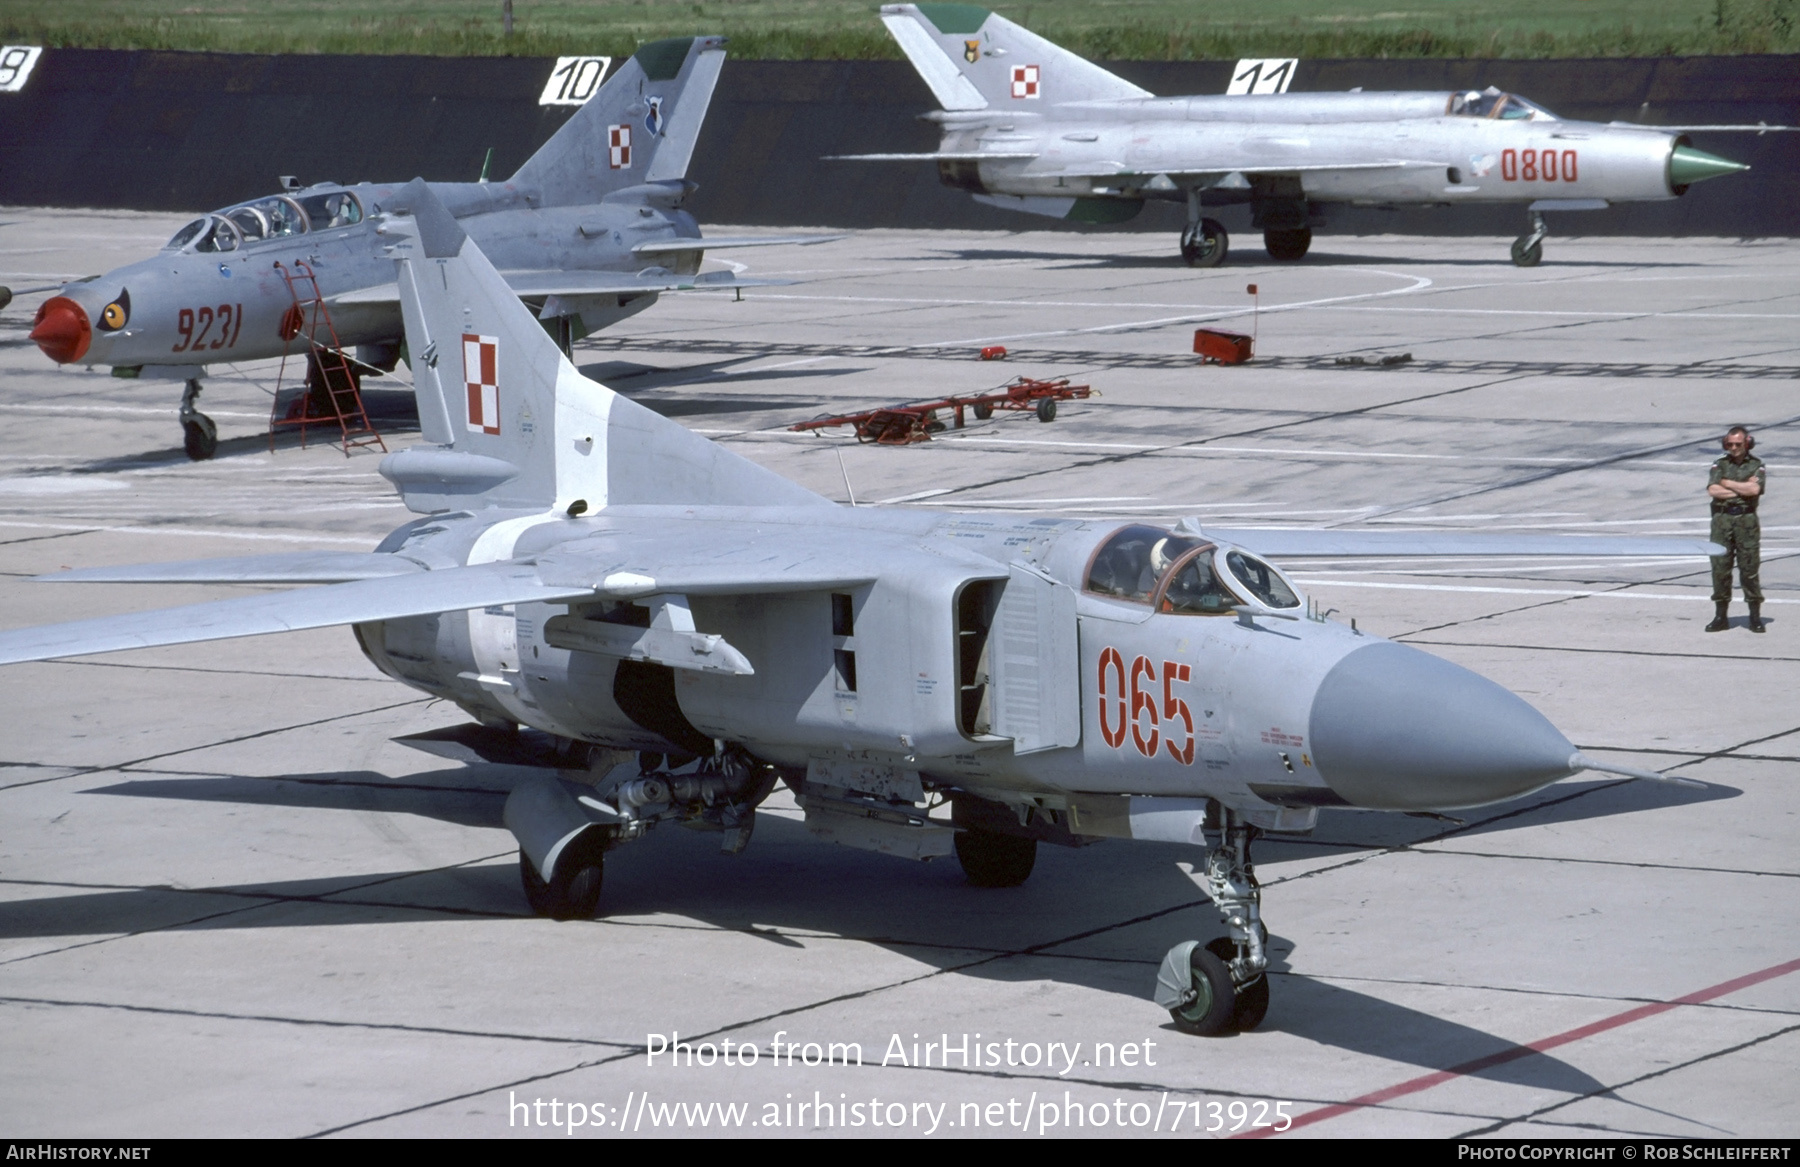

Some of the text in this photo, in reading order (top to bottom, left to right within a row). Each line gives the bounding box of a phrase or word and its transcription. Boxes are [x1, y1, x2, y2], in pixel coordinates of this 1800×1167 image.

[0, 48, 31, 86] 9
[554, 58, 605, 101] 10
[1235, 60, 1293, 95] 11
[1501, 148, 1577, 182] 0800
[171, 303, 242, 353] 9231
[1097, 646, 1195, 766] 065
